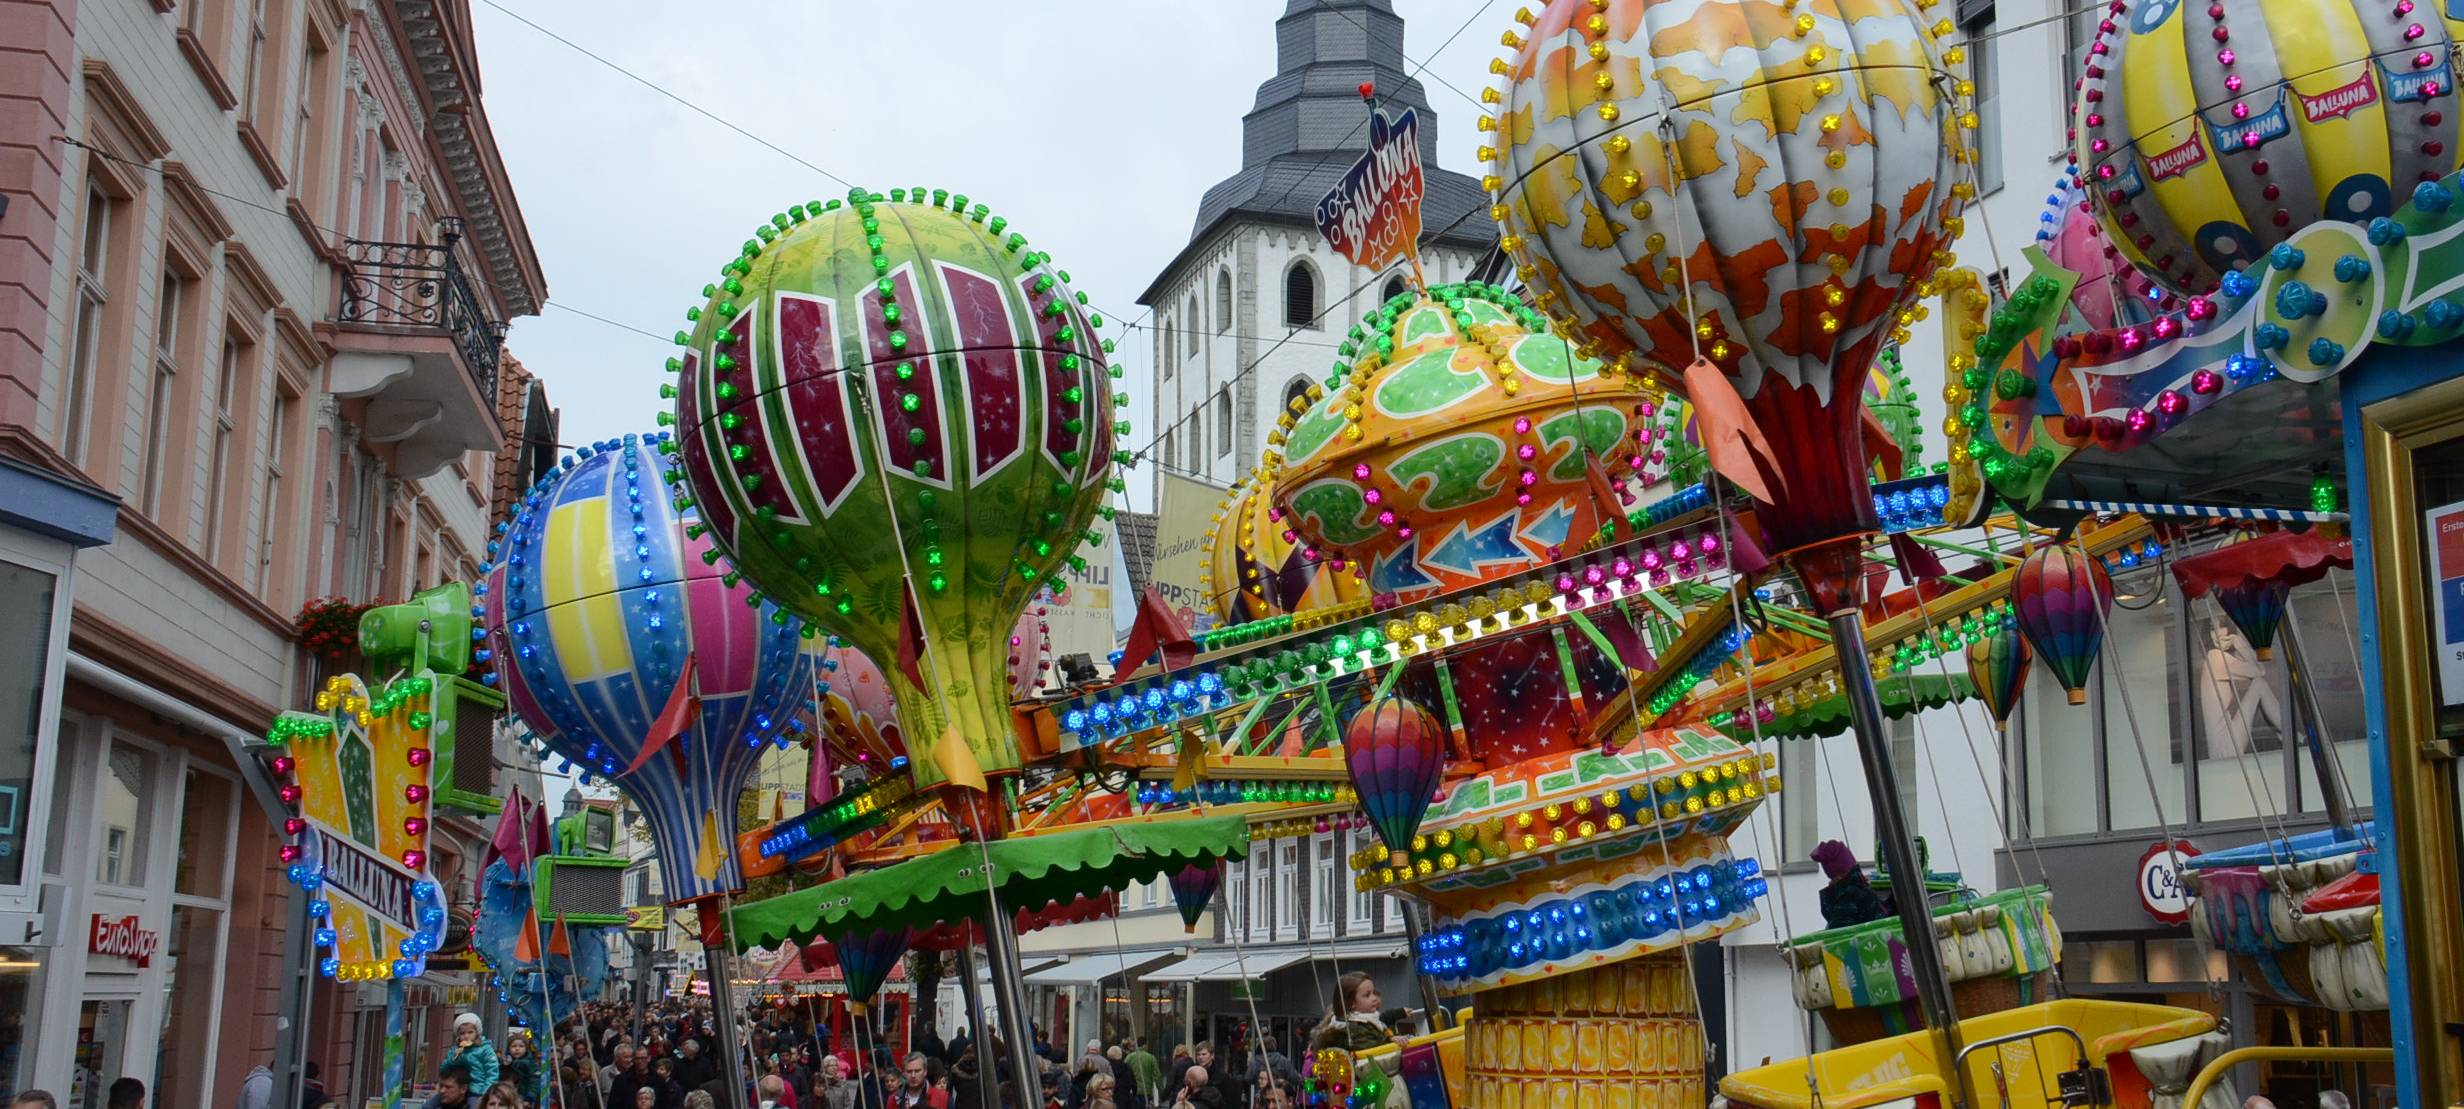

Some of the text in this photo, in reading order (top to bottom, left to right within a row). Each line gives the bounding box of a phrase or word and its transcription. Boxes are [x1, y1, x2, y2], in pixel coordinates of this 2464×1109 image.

[2306, 84, 2369, 119] BALLUNA
[2150, 143, 2200, 178] BALLUNA
[1343, 122, 1418, 264] BALLUNA
[327, 837, 404, 920] BALLUNA
